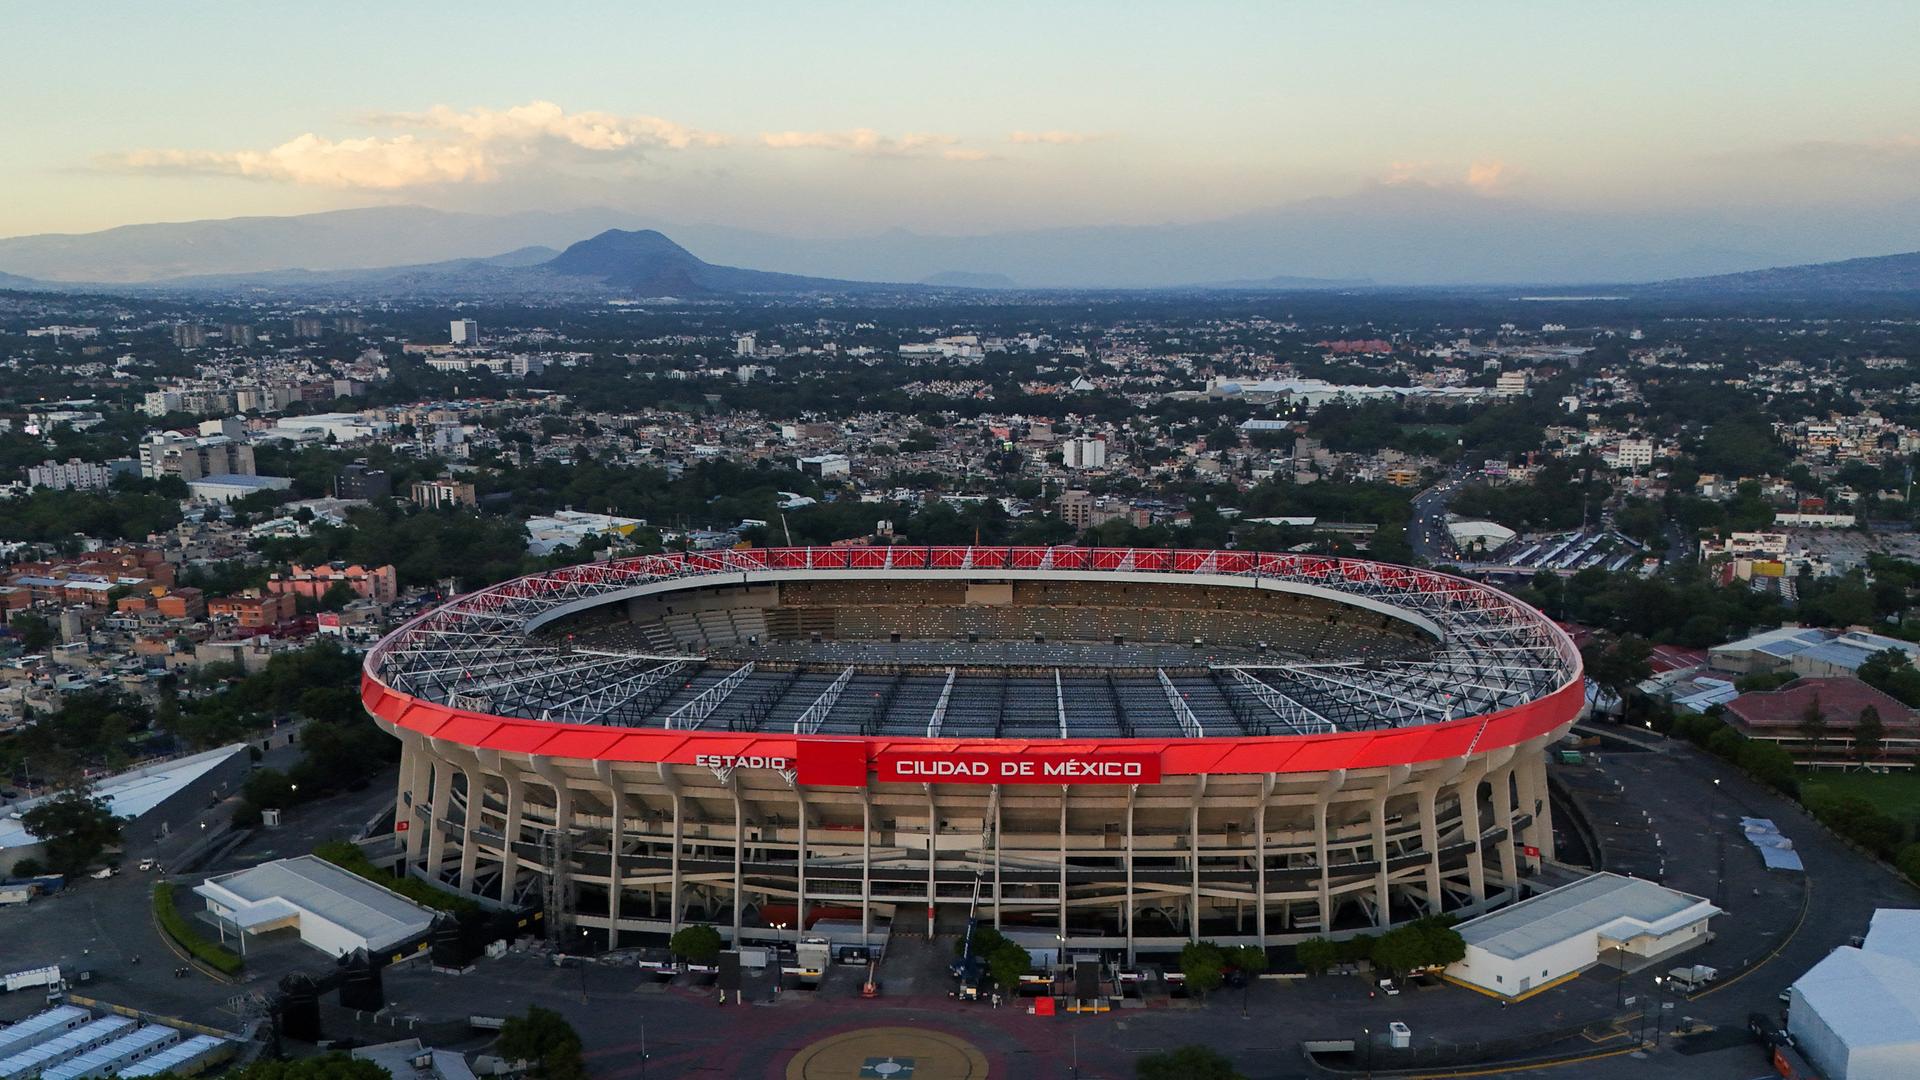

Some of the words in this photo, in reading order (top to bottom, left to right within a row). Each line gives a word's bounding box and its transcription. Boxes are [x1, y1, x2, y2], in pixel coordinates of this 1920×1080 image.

[695, 754, 786, 769] ESTADIO
[896, 760, 989, 776] CIUDAD
[1001, 762, 1035, 776] DE
[1044, 758, 1142, 776] MÉXICO
